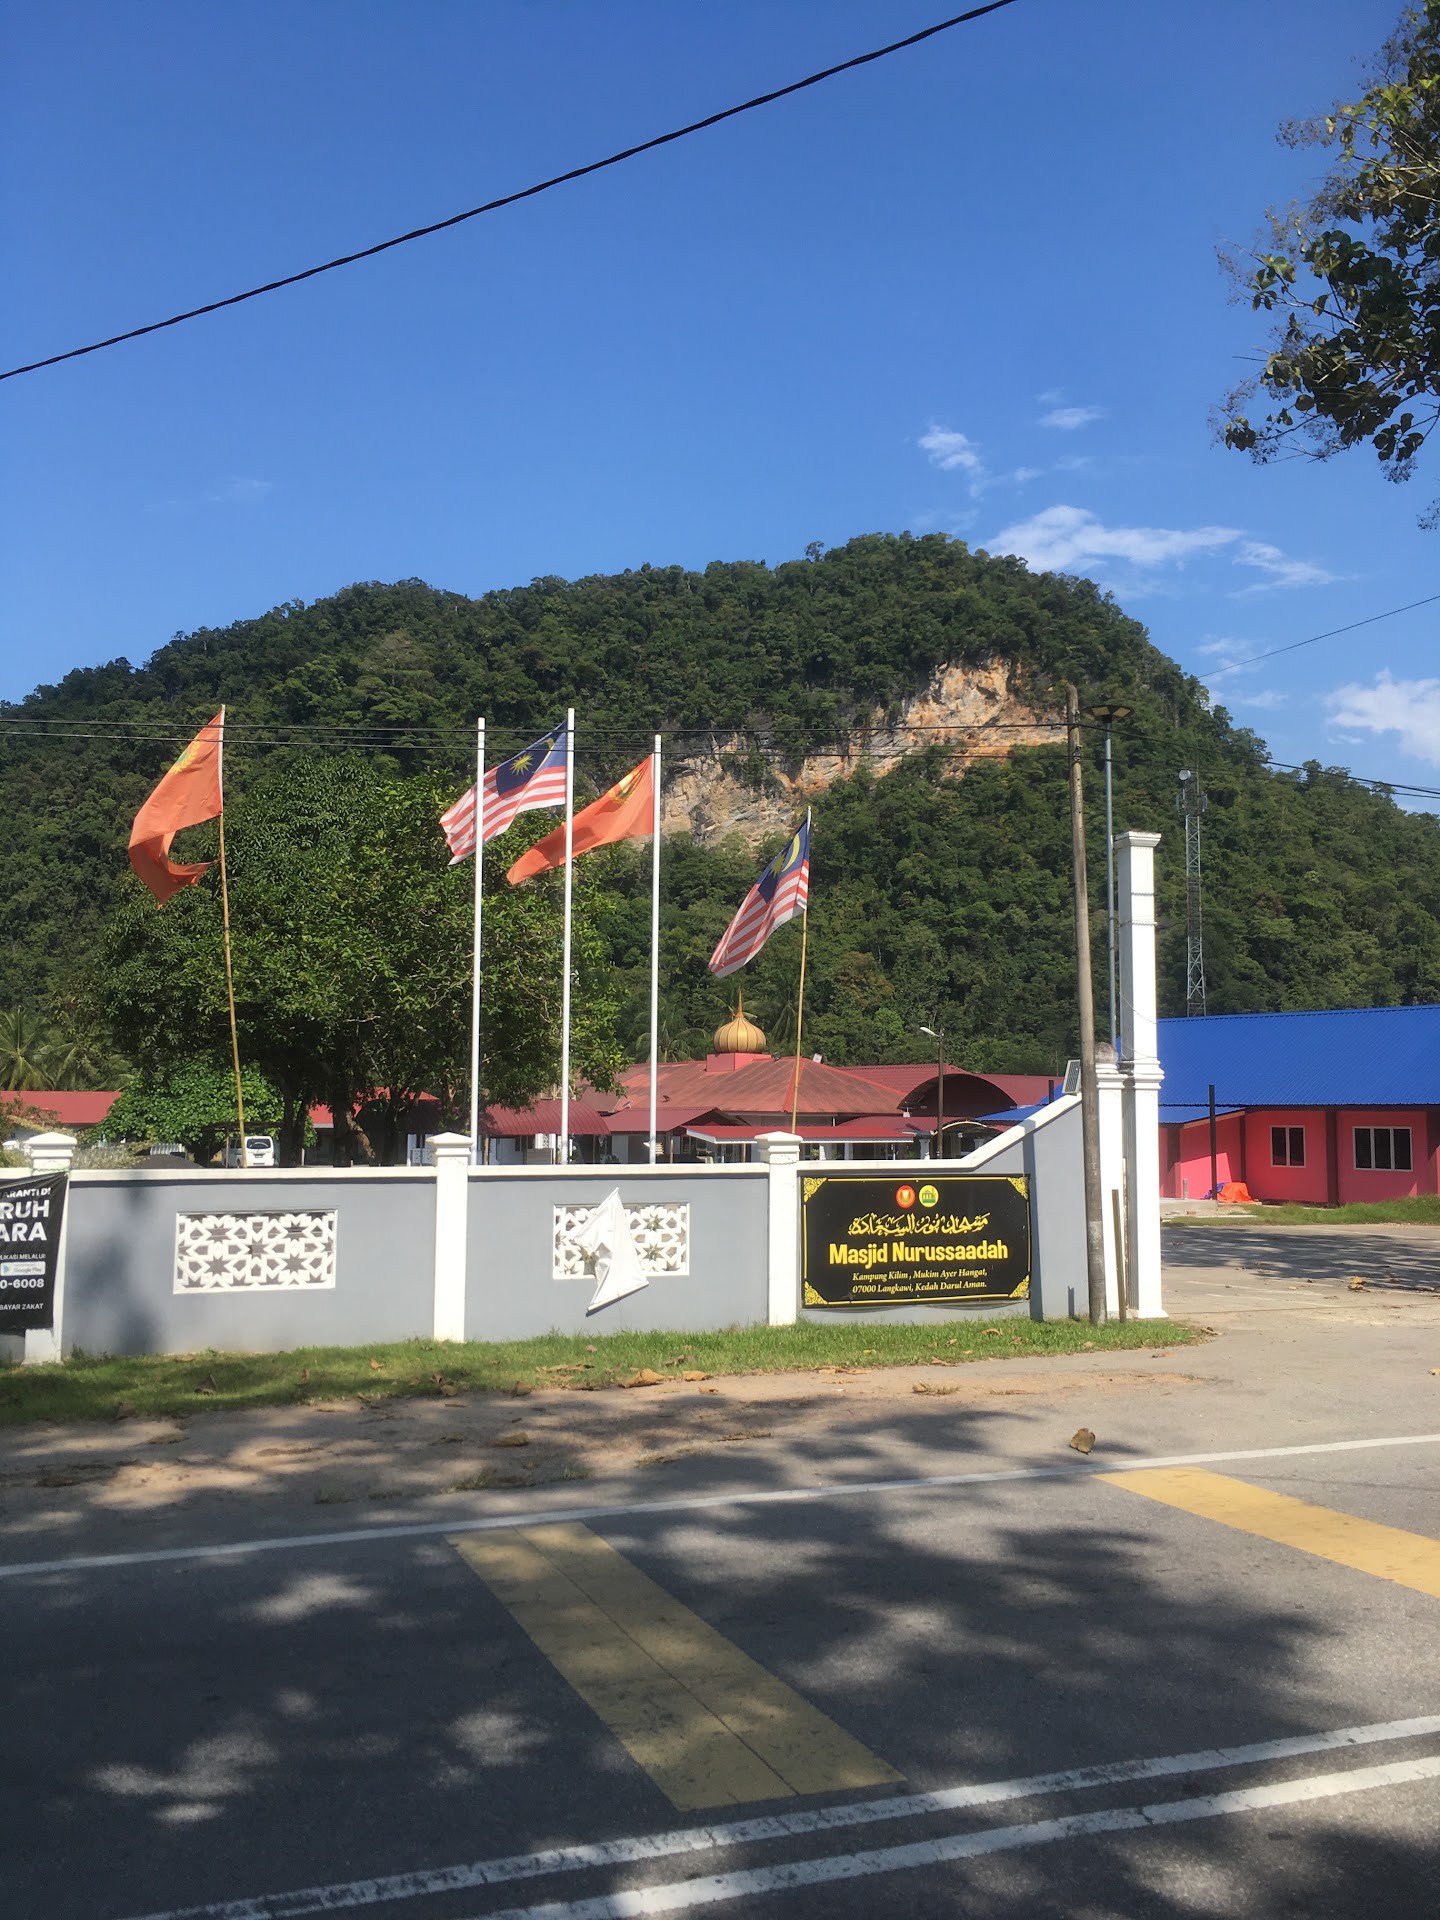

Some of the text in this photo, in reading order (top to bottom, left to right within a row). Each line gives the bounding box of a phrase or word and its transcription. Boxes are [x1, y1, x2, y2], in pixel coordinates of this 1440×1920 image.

[0, 1199, 50, 1219] RUH
[0, 1221, 48, 1242] ARA
[829, 1239, 1008, 1269] Masjid Nurussaadah
[852, 1272, 888, 1282] Kampung
[913, 1269, 939, 1279] Mukim
[940, 1269, 958, 1280] Ayer
[958, 1268, 988, 1278] Hangat,
[0, 1278, 45, 1289] 0-6008
[852, 1280, 988, 1294] 07000 Langkawi, Kedah Darul Aman.
[21, 1302, 44, 1310] ZAKAT
